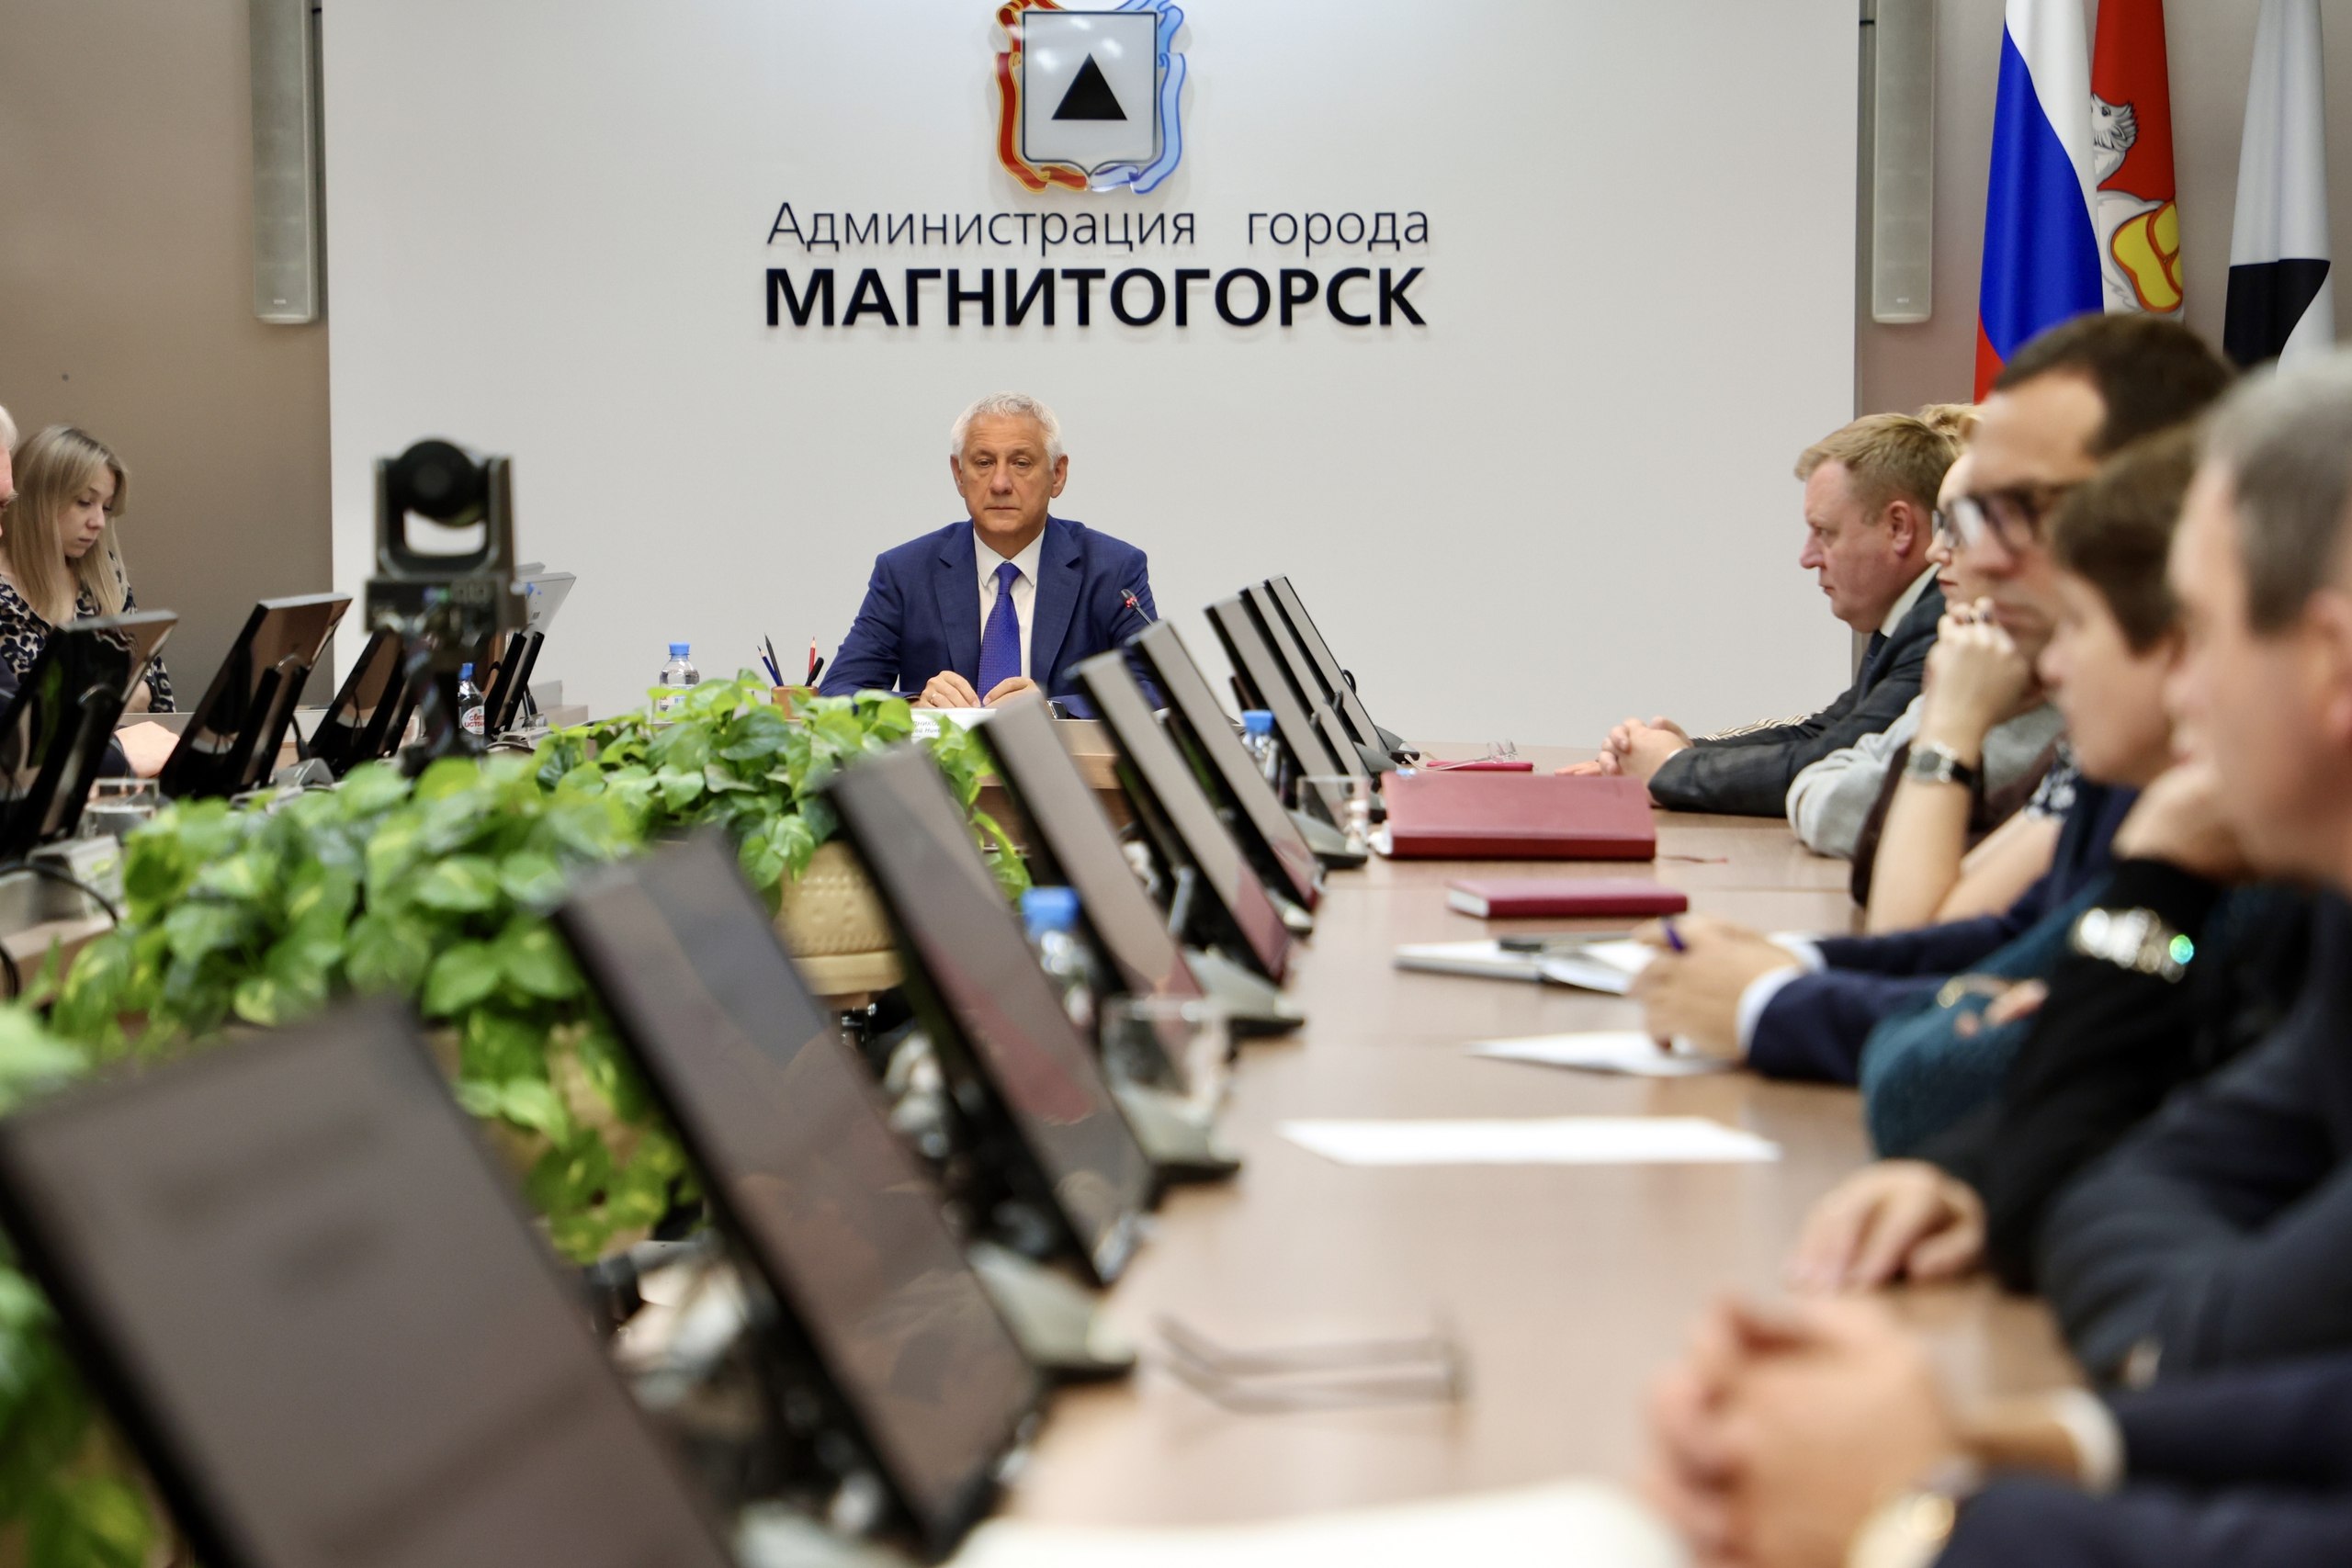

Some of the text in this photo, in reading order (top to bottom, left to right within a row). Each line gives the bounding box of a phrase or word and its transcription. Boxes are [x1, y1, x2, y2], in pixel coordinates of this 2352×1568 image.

[766, 202, 1429, 257] Администрация города
[765, 267, 1427, 327] МАГНИТОГОРСК
